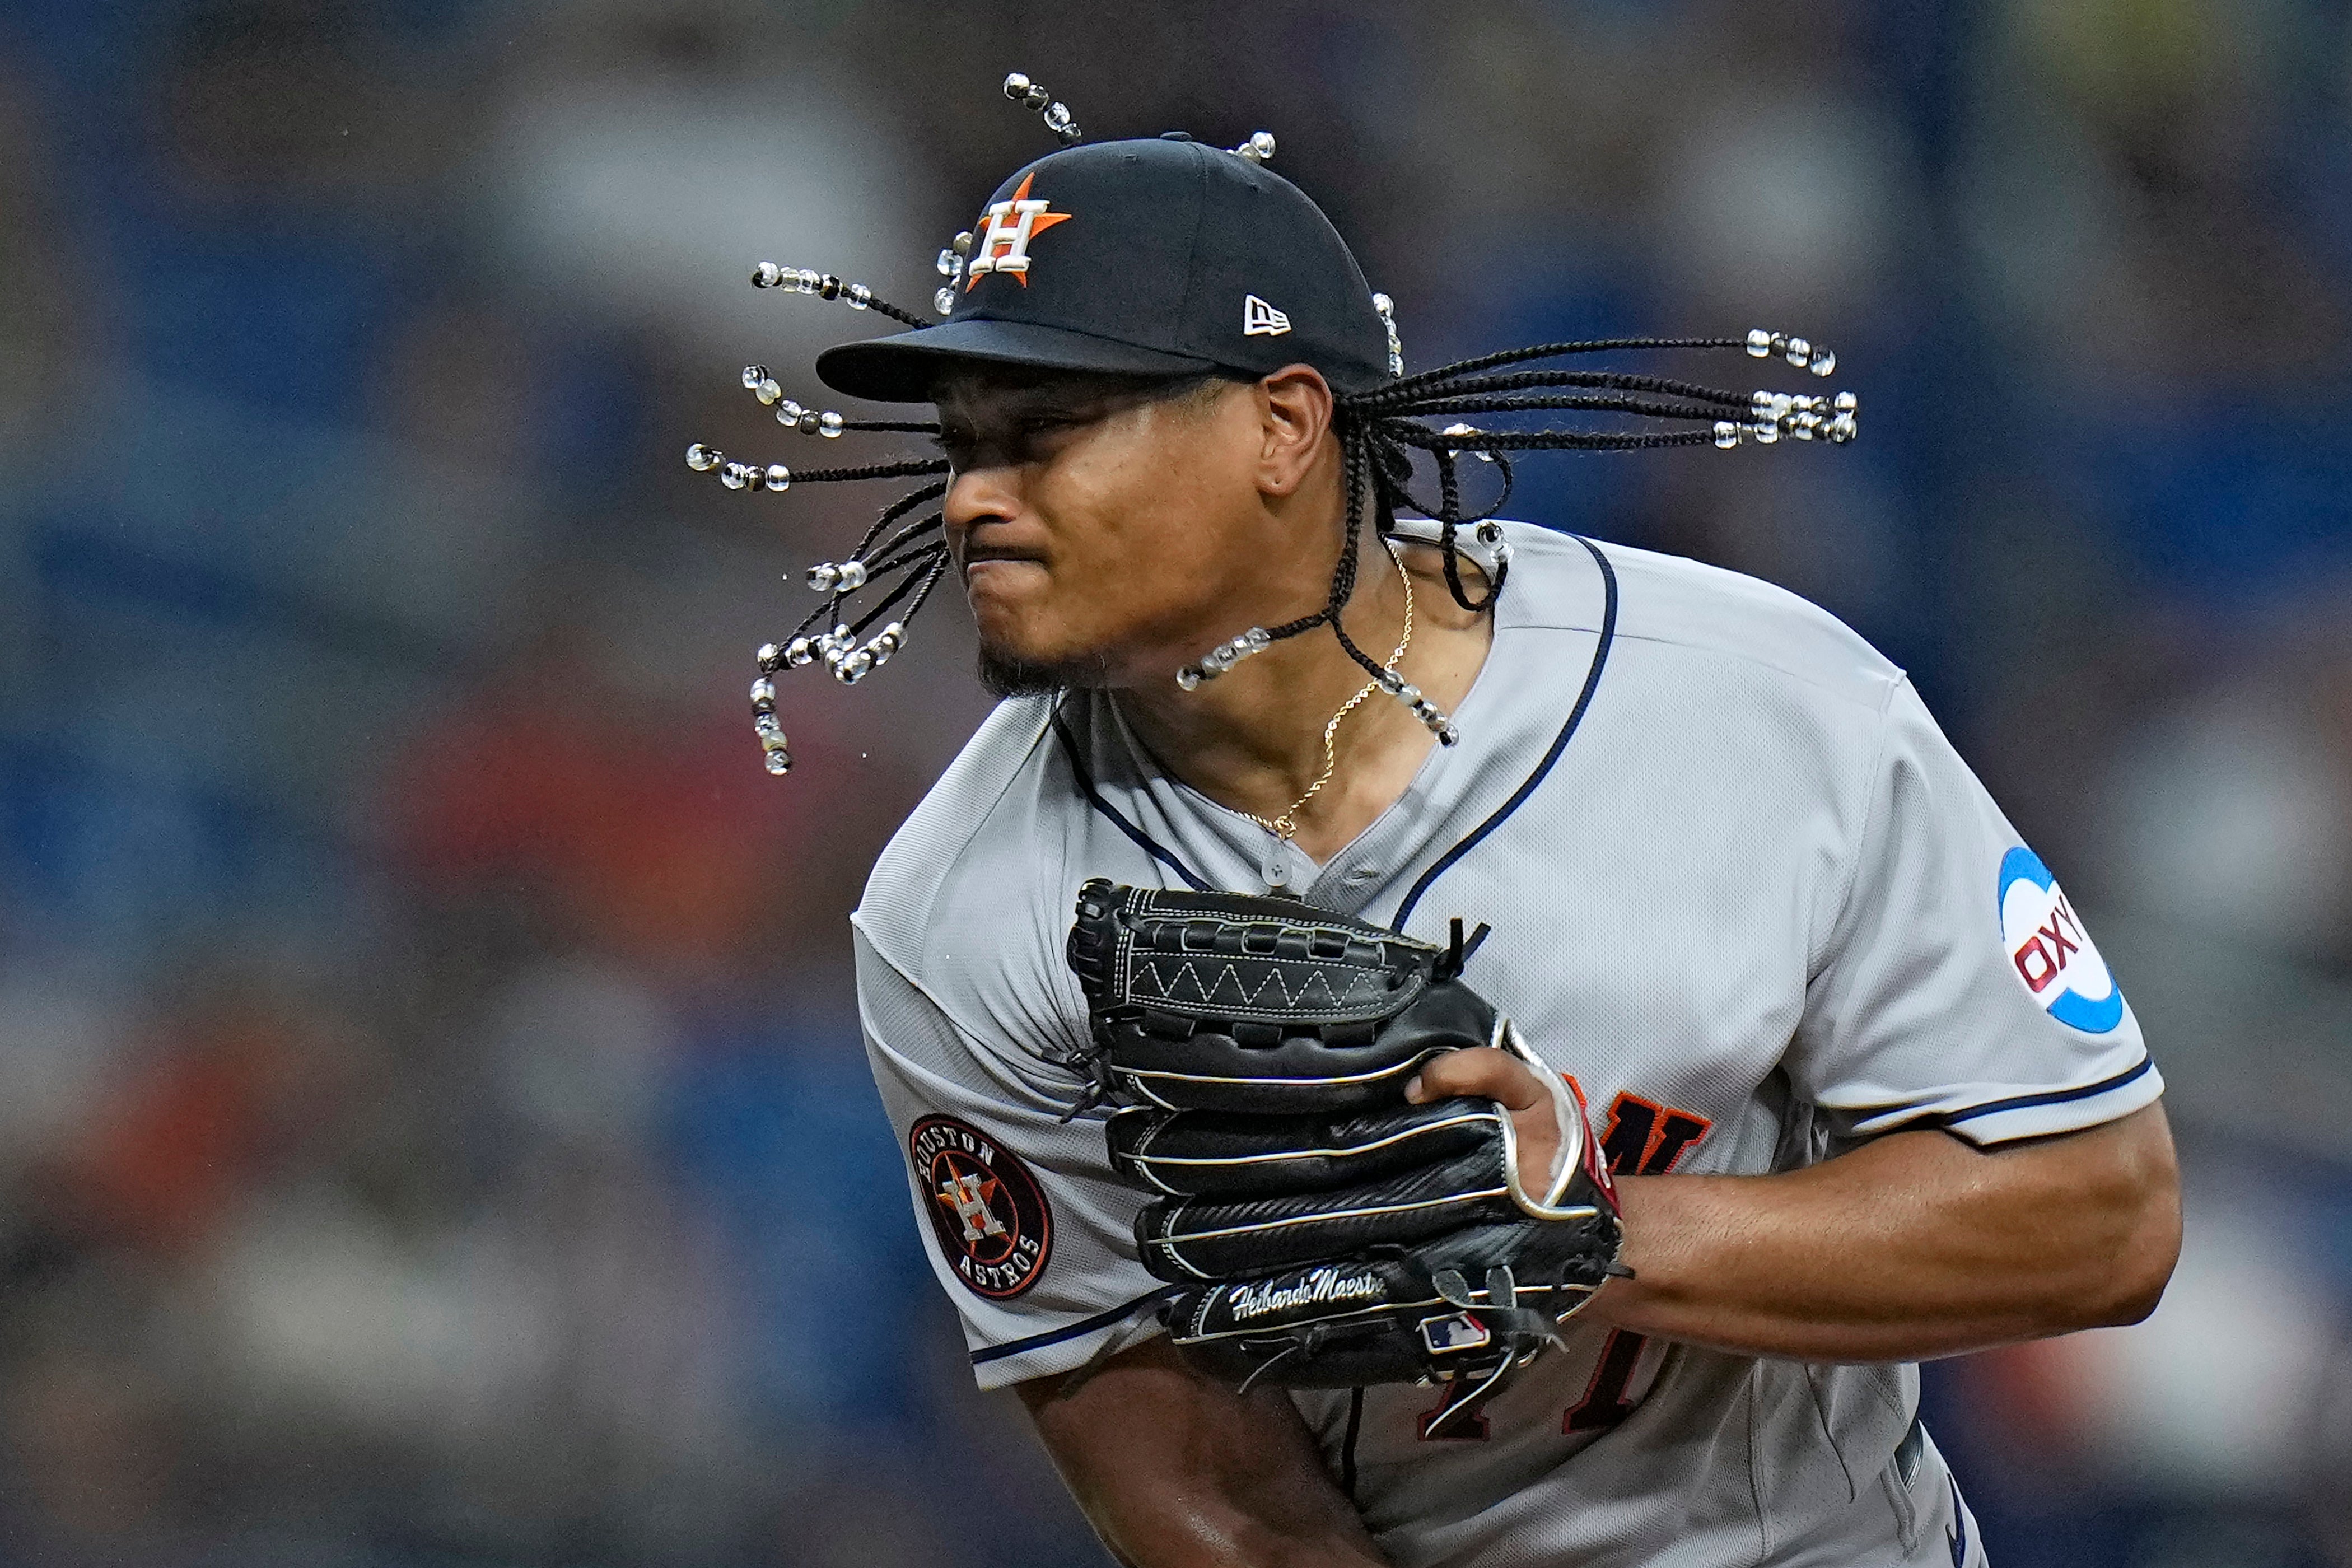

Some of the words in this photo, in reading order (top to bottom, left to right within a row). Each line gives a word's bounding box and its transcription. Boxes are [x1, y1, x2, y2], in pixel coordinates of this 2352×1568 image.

[968, 199, 1051, 276] H
[2014, 894, 2083, 993] OXY
[917, 1126, 995, 1183] HOUSTON
[959, 1234, 1040, 1289] ASTROS
